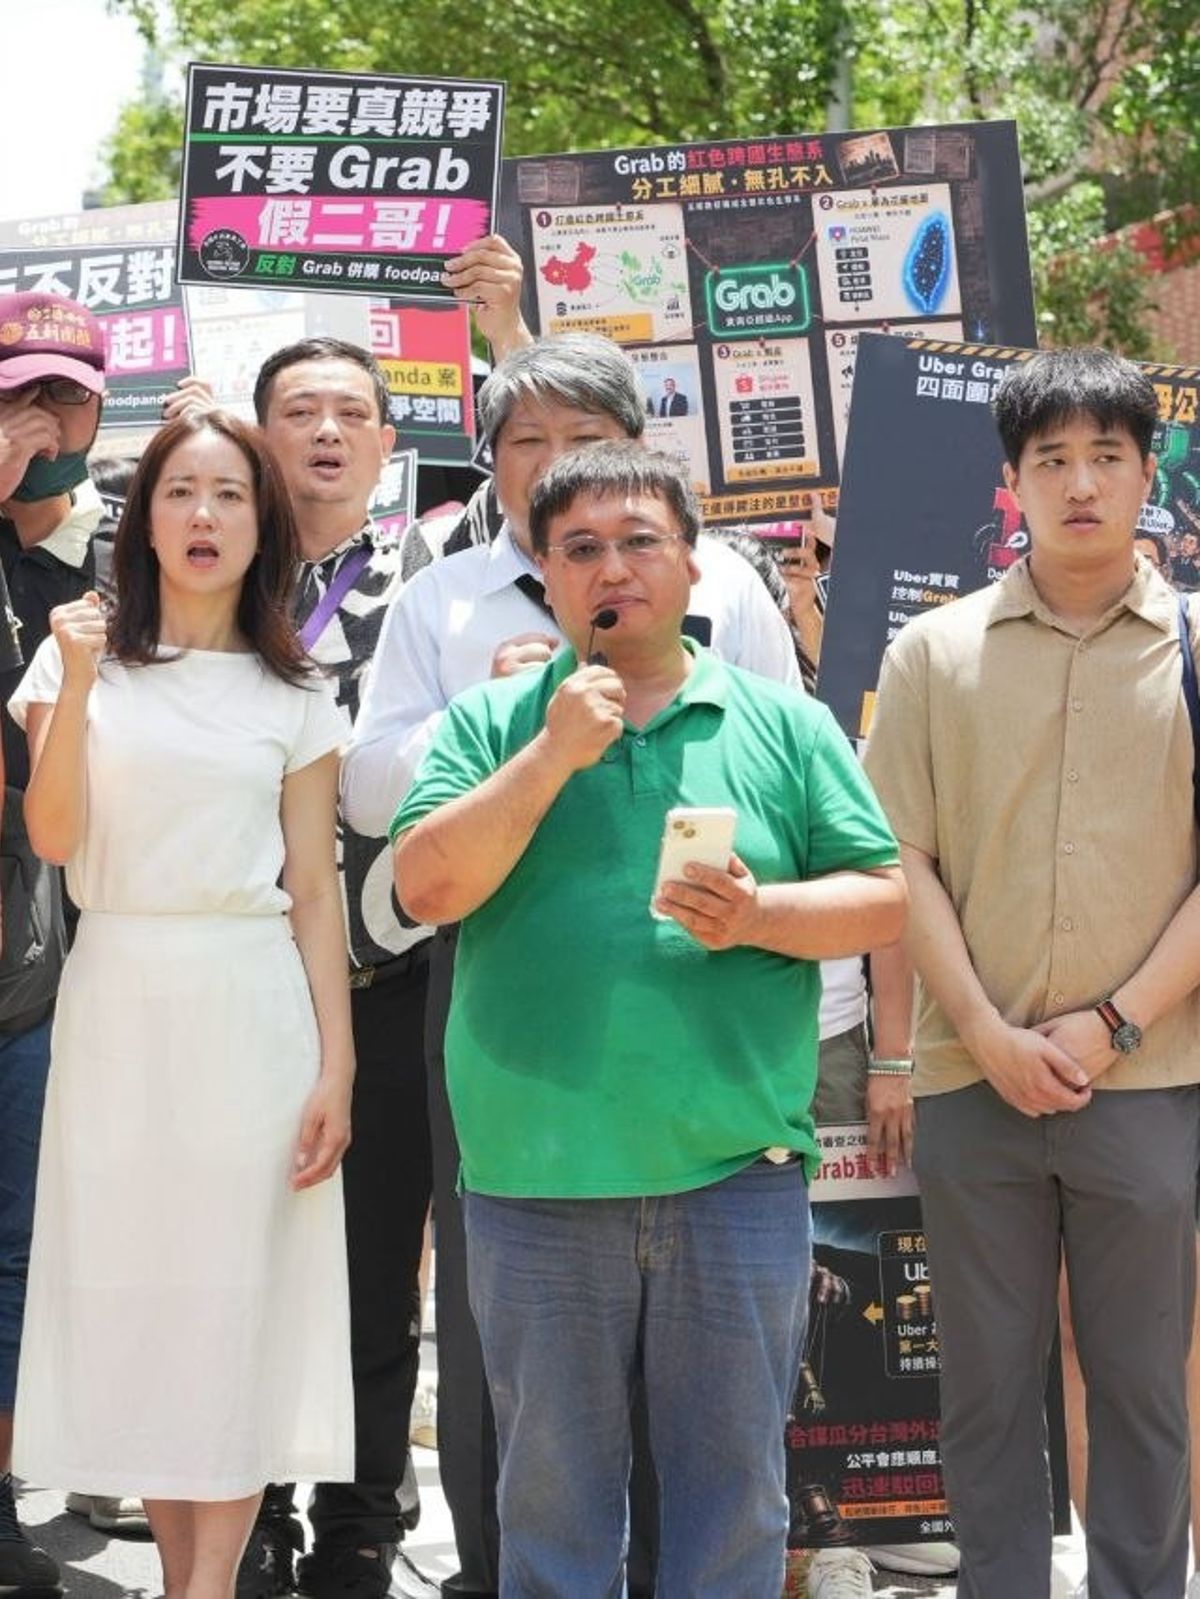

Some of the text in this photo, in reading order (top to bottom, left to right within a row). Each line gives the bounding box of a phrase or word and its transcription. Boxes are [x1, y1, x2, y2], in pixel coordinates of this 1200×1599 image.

[202, 81, 492, 138] 市場要真競爭
[214, 144, 471, 194] 不要 Grab
[614, 152, 665, 175] Grab
[255, 254, 448, 284] 反對 Grab 併購 foodpa
[714, 273, 796, 312] Grab
[918, 355, 965, 375] Uber
[104, 392, 167, 408] oodpand
[903, 1262, 930, 1281] Ub
[897, 1323, 928, 1337] Uber
